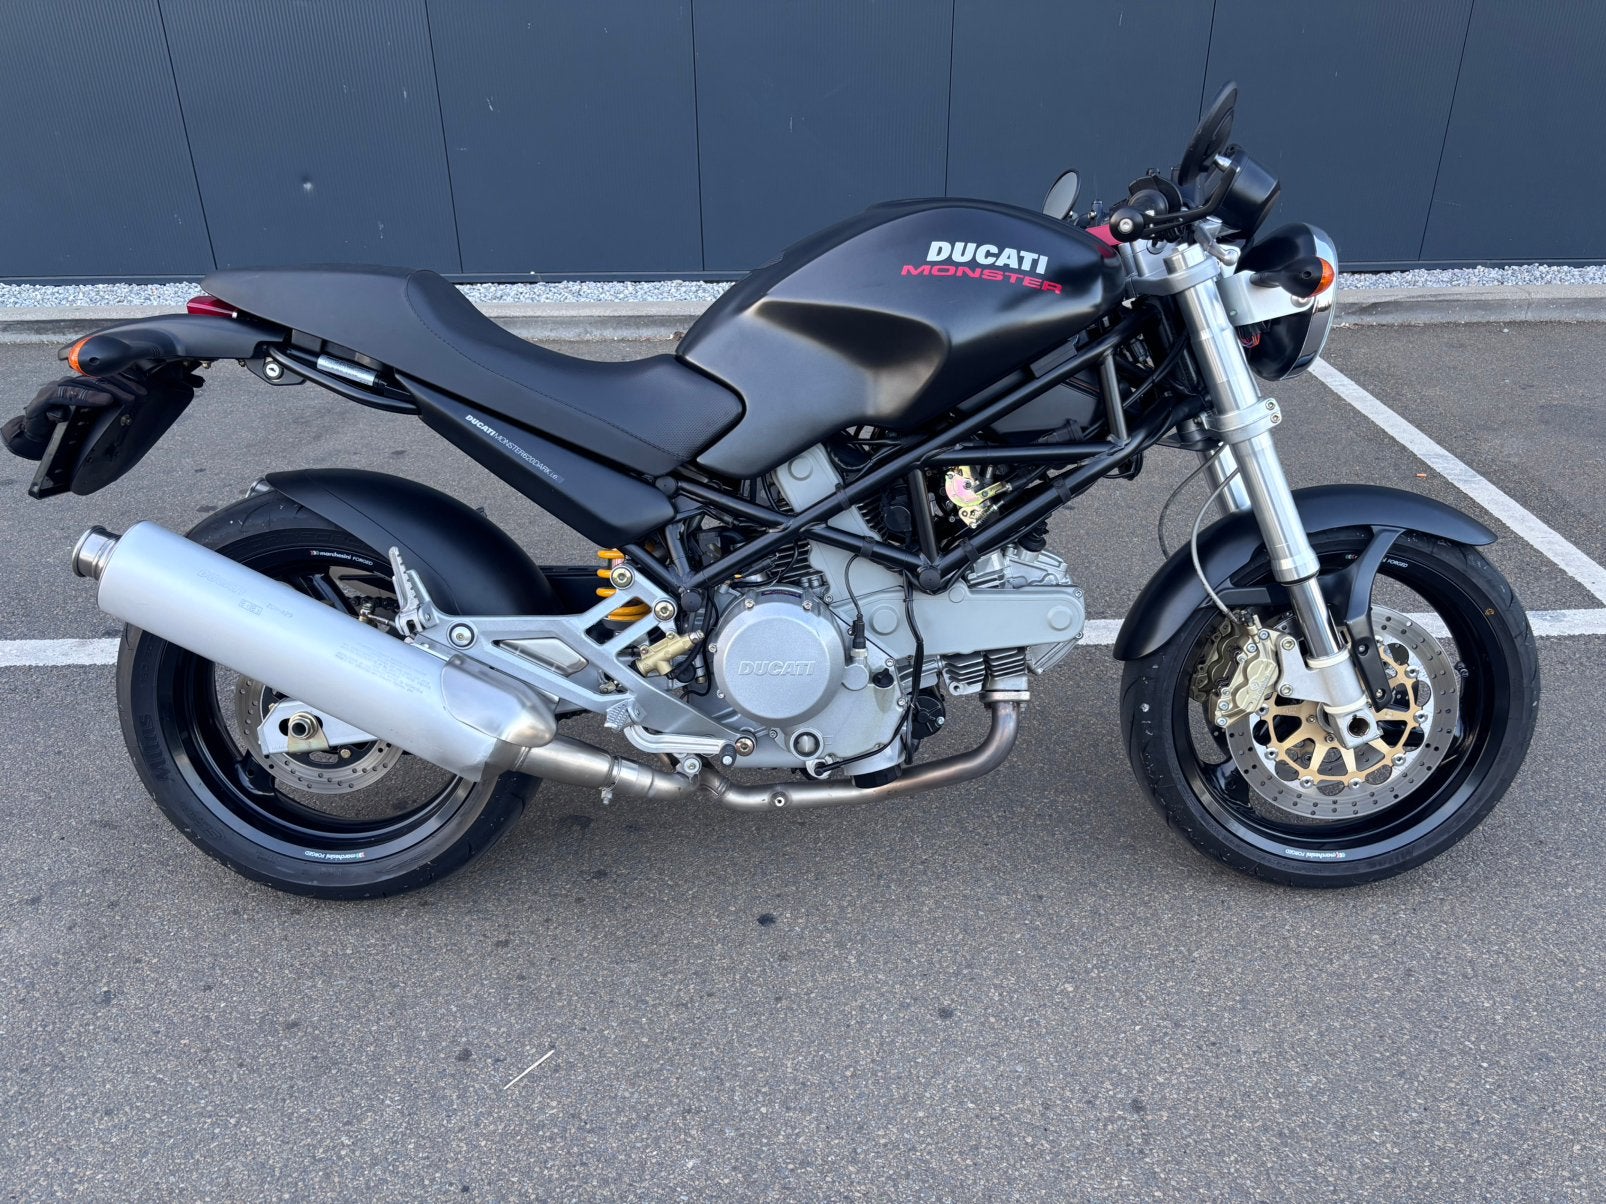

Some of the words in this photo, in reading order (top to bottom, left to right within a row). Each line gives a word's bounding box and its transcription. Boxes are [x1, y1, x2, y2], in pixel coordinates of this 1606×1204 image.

[926, 241, 1048, 275] DUCATI
[901, 265, 1064, 295] MONSTER
[352, 556, 374, 566] FORGED
[737, 660, 816, 677] DUCATI
